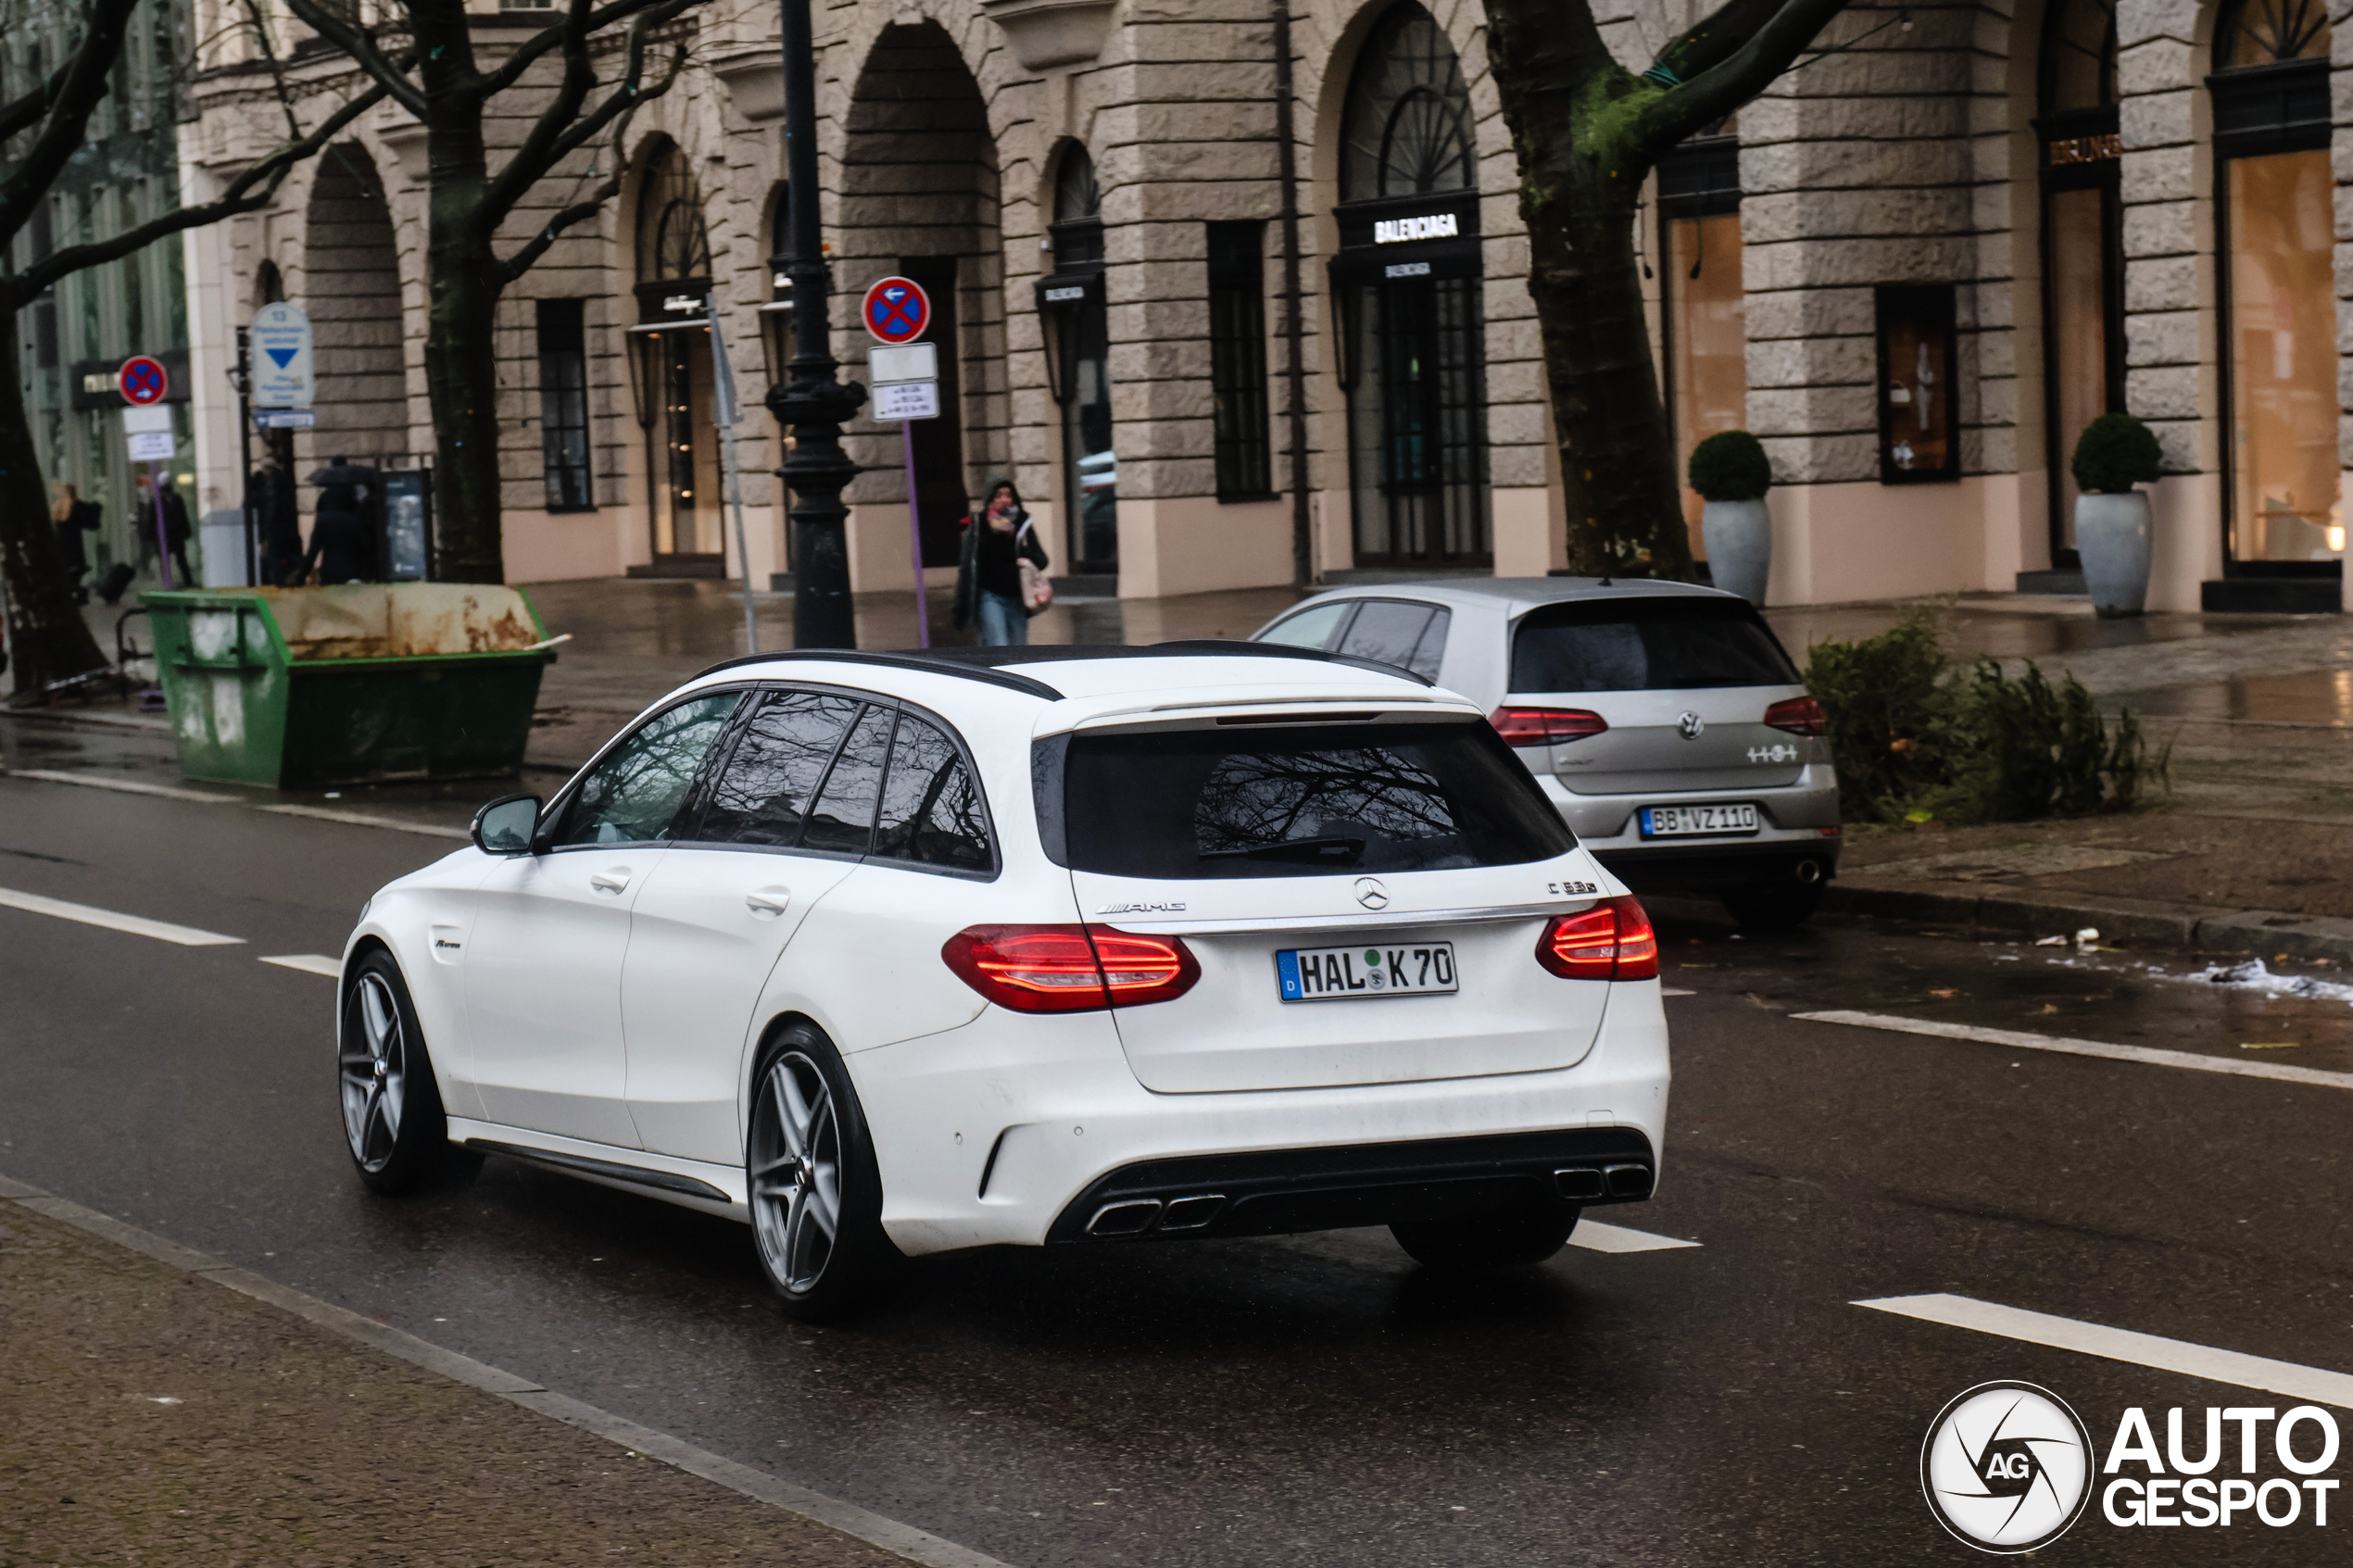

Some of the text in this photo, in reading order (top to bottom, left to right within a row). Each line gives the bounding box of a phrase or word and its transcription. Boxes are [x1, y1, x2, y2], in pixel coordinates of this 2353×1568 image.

[1375, 213, 1458, 245] BALENCIAGA
[1654, 807, 1754, 831] BB VZ 110
[1124, 901, 1186, 912] AMG
[1300, 947, 1453, 993] HAL K 70
[1286, 980, 1296, 992] D
